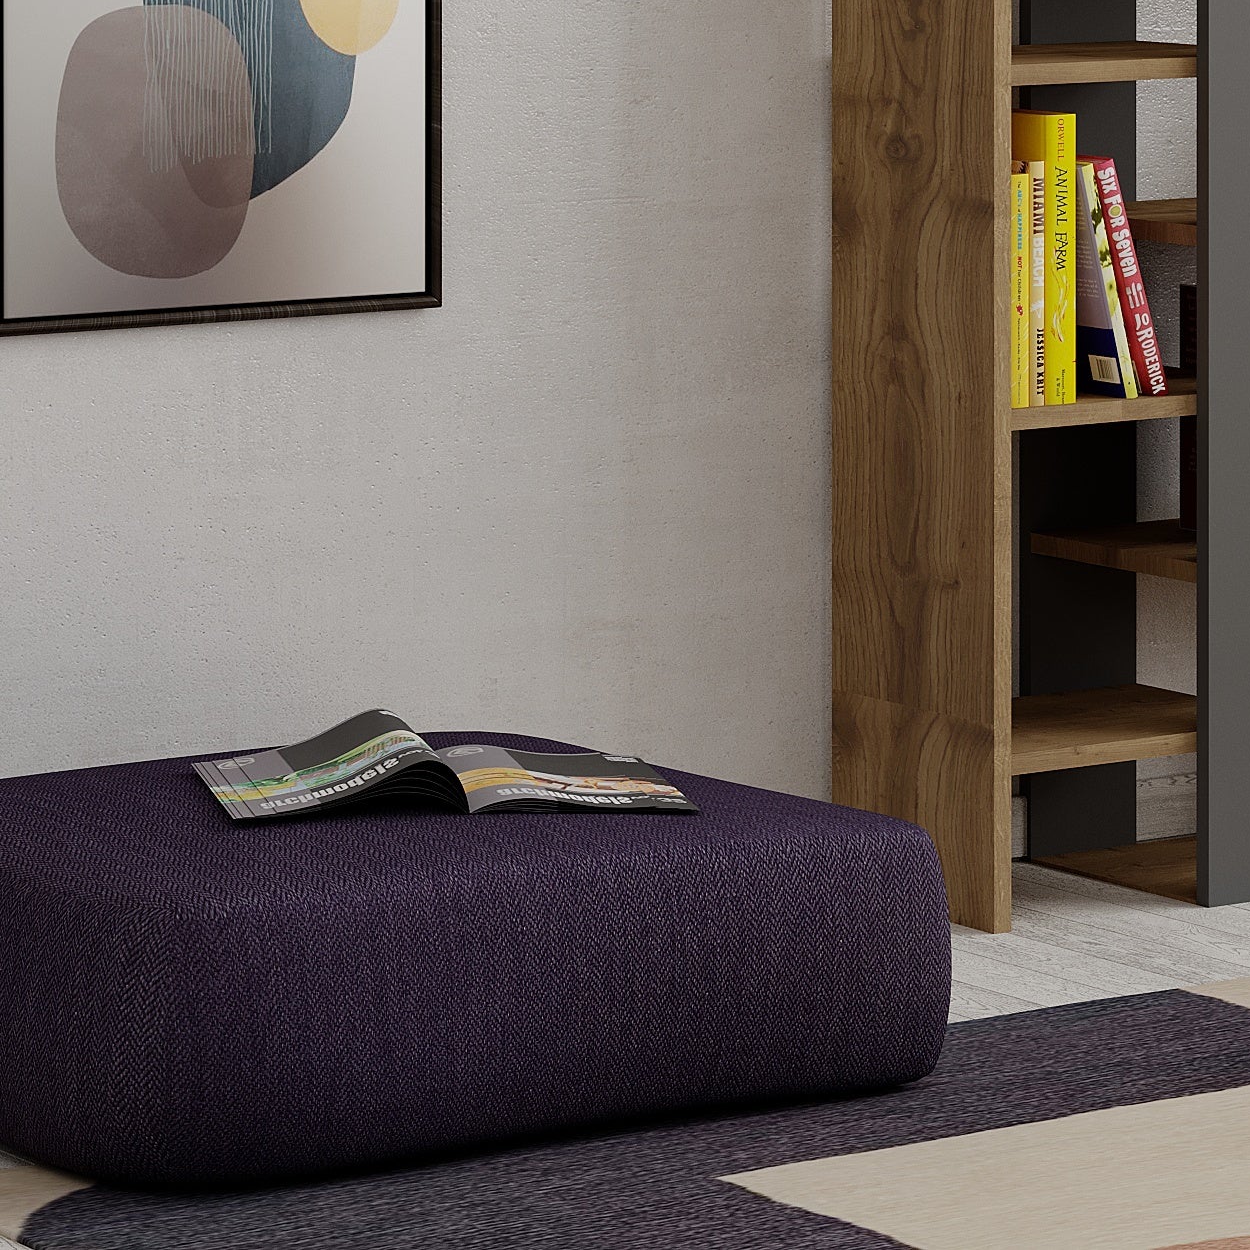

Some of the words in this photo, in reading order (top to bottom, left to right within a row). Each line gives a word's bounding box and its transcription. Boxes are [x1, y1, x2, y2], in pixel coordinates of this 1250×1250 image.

[1057, 118, 1065, 161] ORWELL
[1032, 178, 1044, 234] MIAMI
[1054, 167, 1068, 225] ANIMAL
[1032, 237, 1044, 287] BEACH
[1055, 232, 1069, 271] FARM
